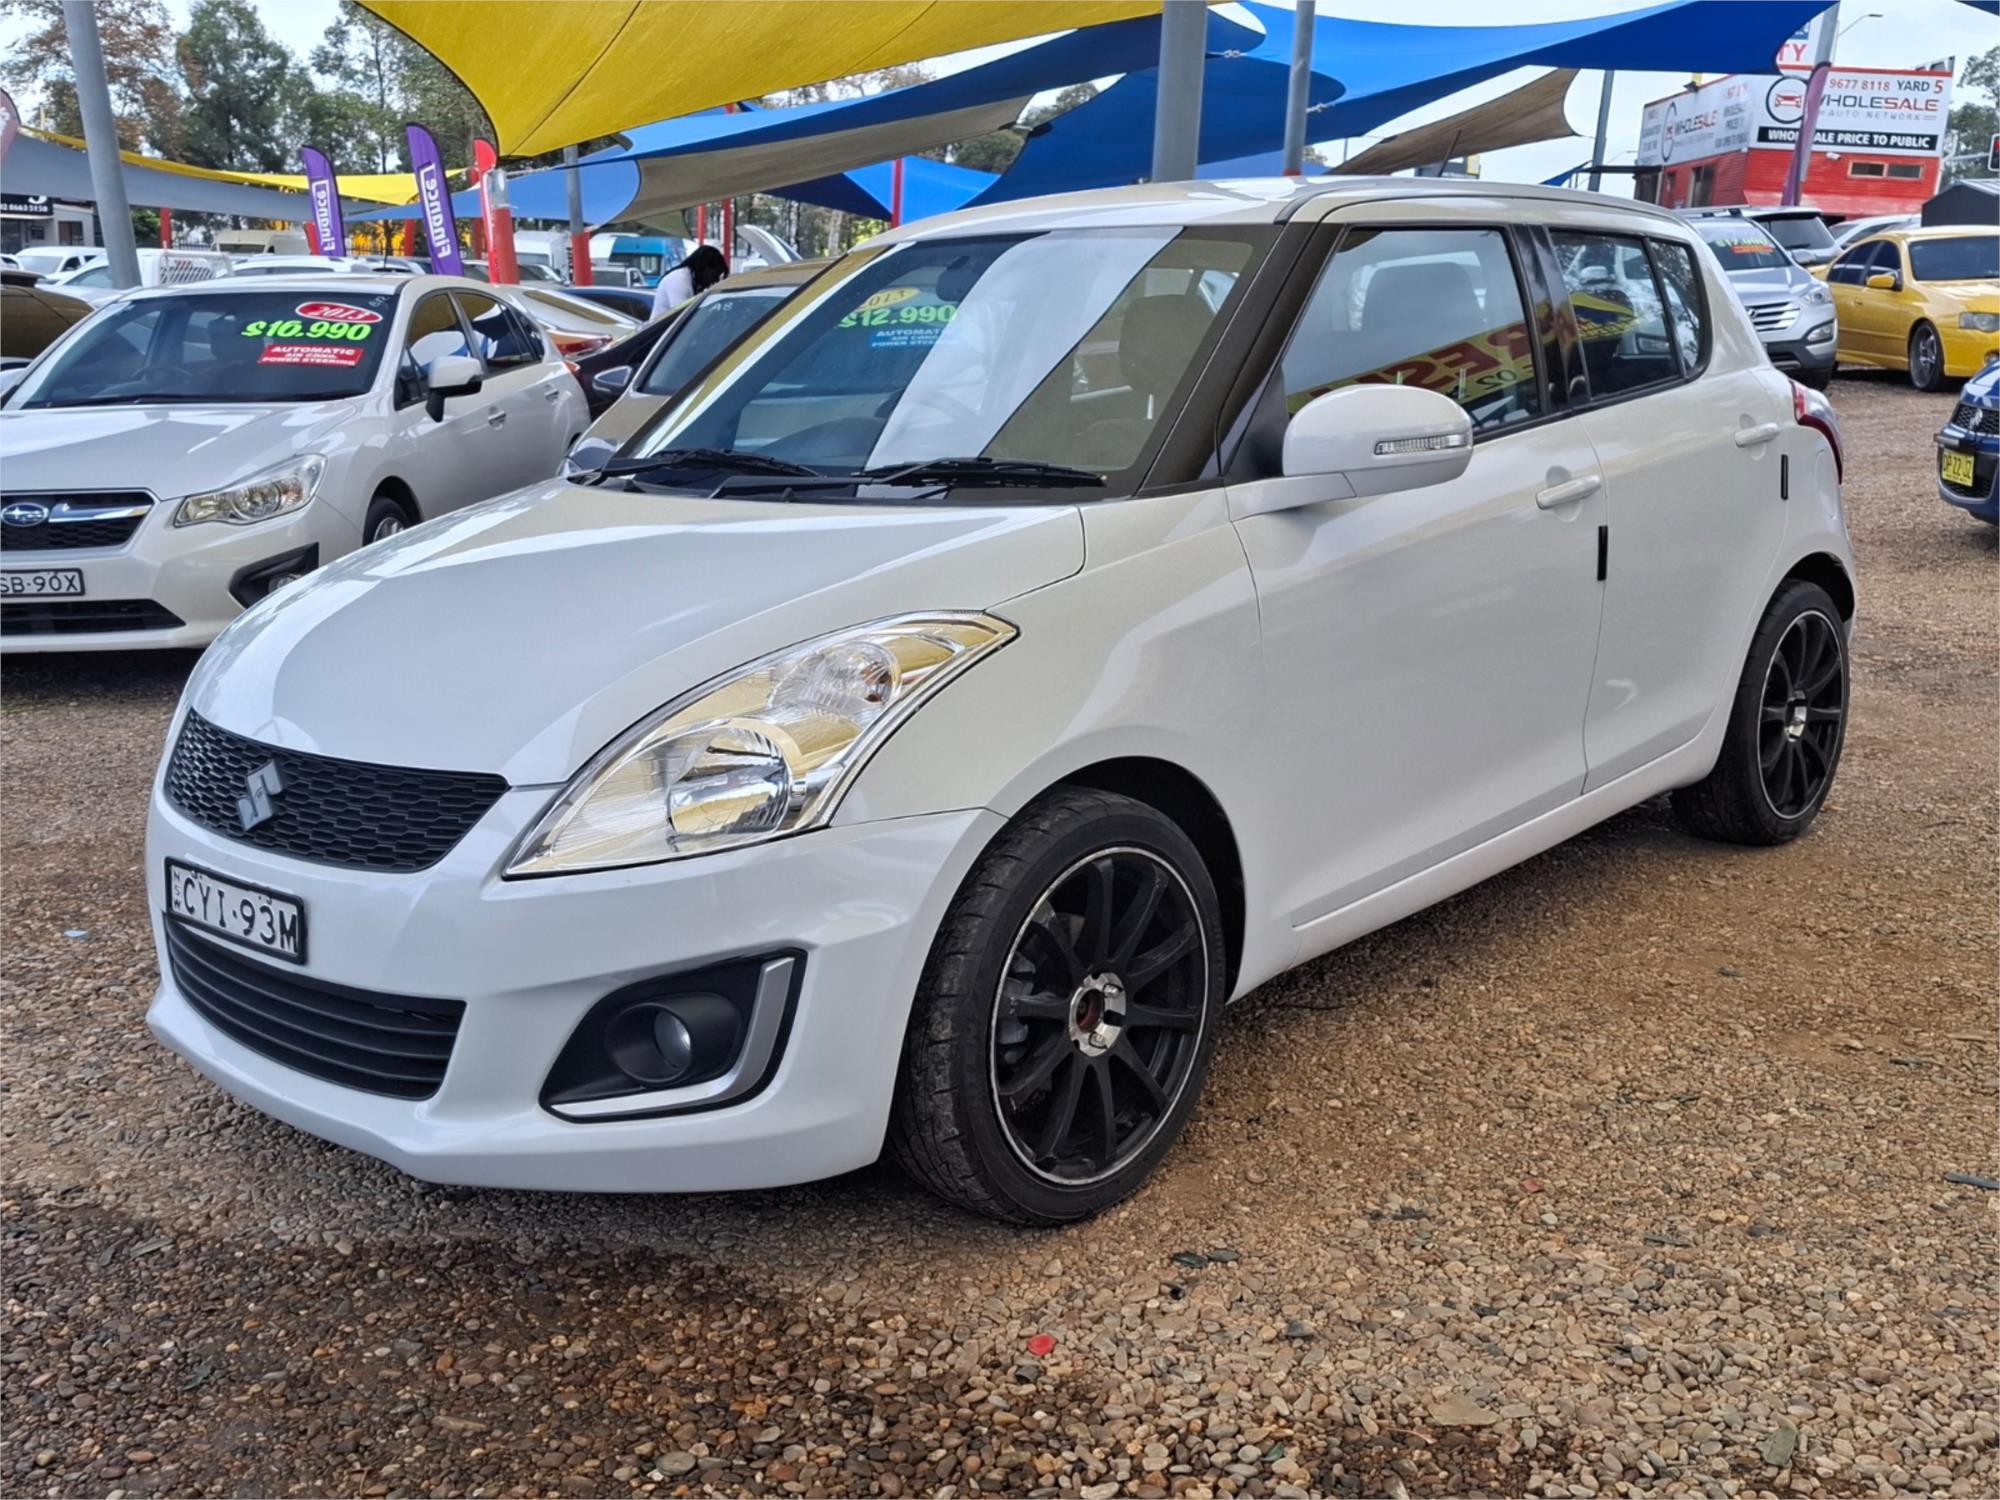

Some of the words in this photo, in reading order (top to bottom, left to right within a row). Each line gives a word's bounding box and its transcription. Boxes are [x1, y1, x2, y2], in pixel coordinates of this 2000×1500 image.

[1829, 79, 1857, 90] 9677
[1861, 80, 1890, 92] 8118
[1897, 80, 1930, 93] YARD
[1934, 80, 1944, 94] 5
[1828, 110, 1859, 119] AUTO
[1867, 111, 1921, 121] NETWORK
[1768, 129, 1834, 144] WHOALE
[1838, 132, 1870, 146] PRICE
[1872, 135, 1887, 146] TO
[1890, 135, 1931, 148] PUBLIC
[308, 306, 371, 320] 2013
[838, 305, 958, 329] $12.990
[875, 329, 941, 337] AUTOMAT
[271, 346, 355, 355] AUTOMATIC
